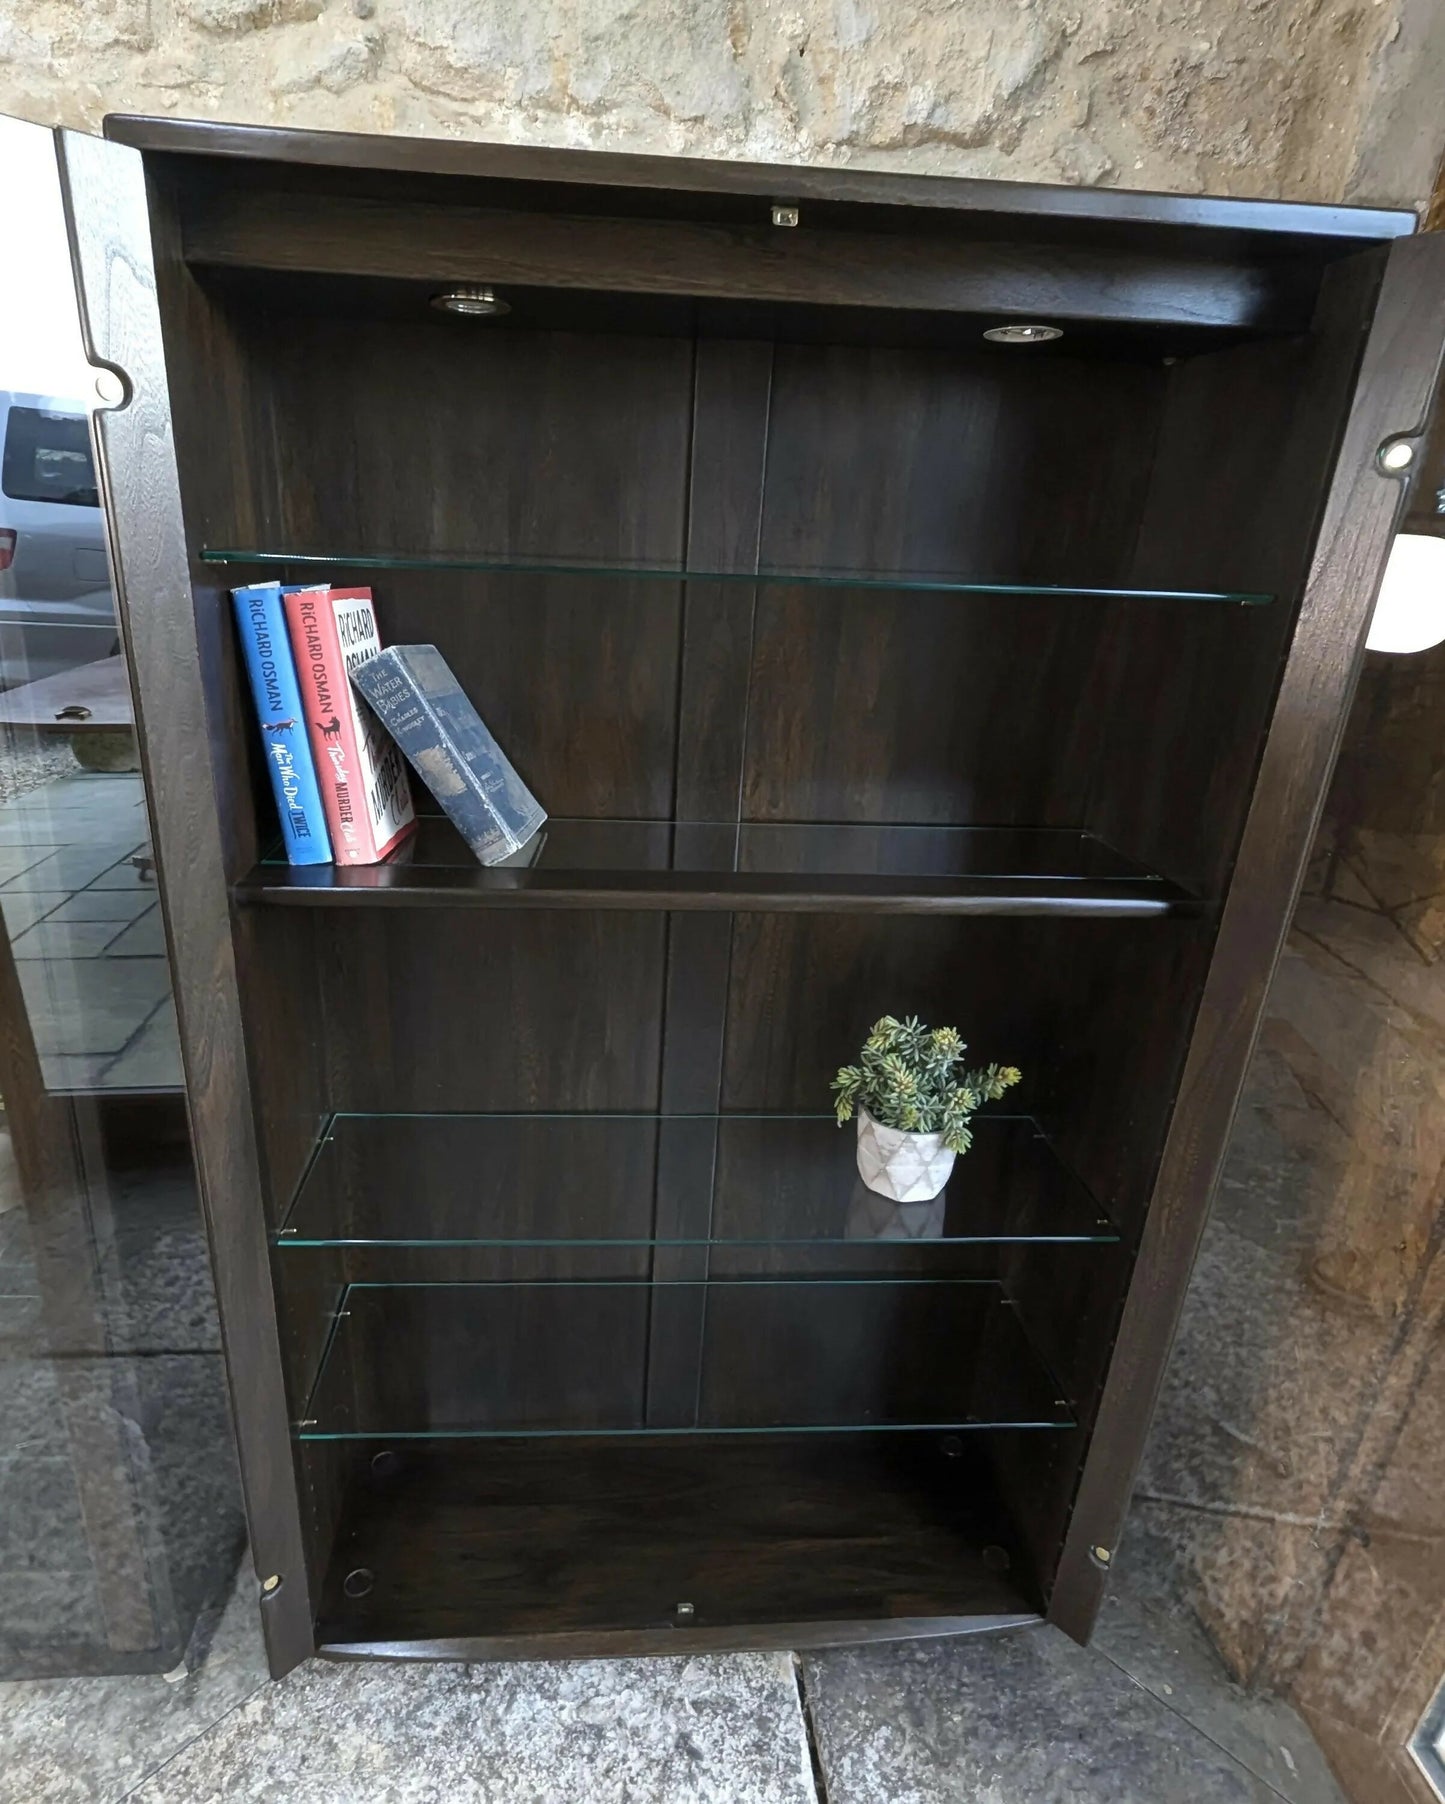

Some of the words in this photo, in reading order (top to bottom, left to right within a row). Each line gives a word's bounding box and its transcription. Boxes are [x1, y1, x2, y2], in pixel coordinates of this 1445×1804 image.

[261, 661, 283, 711] OSMAN
[312, 664, 333, 713] OSMAN
[270, 742, 288, 765] Man
[279, 765, 300, 786] Who
[284, 786, 303, 811] Died
[335, 782, 353, 823] MURDER
[291, 810, 311, 837] TWICE
